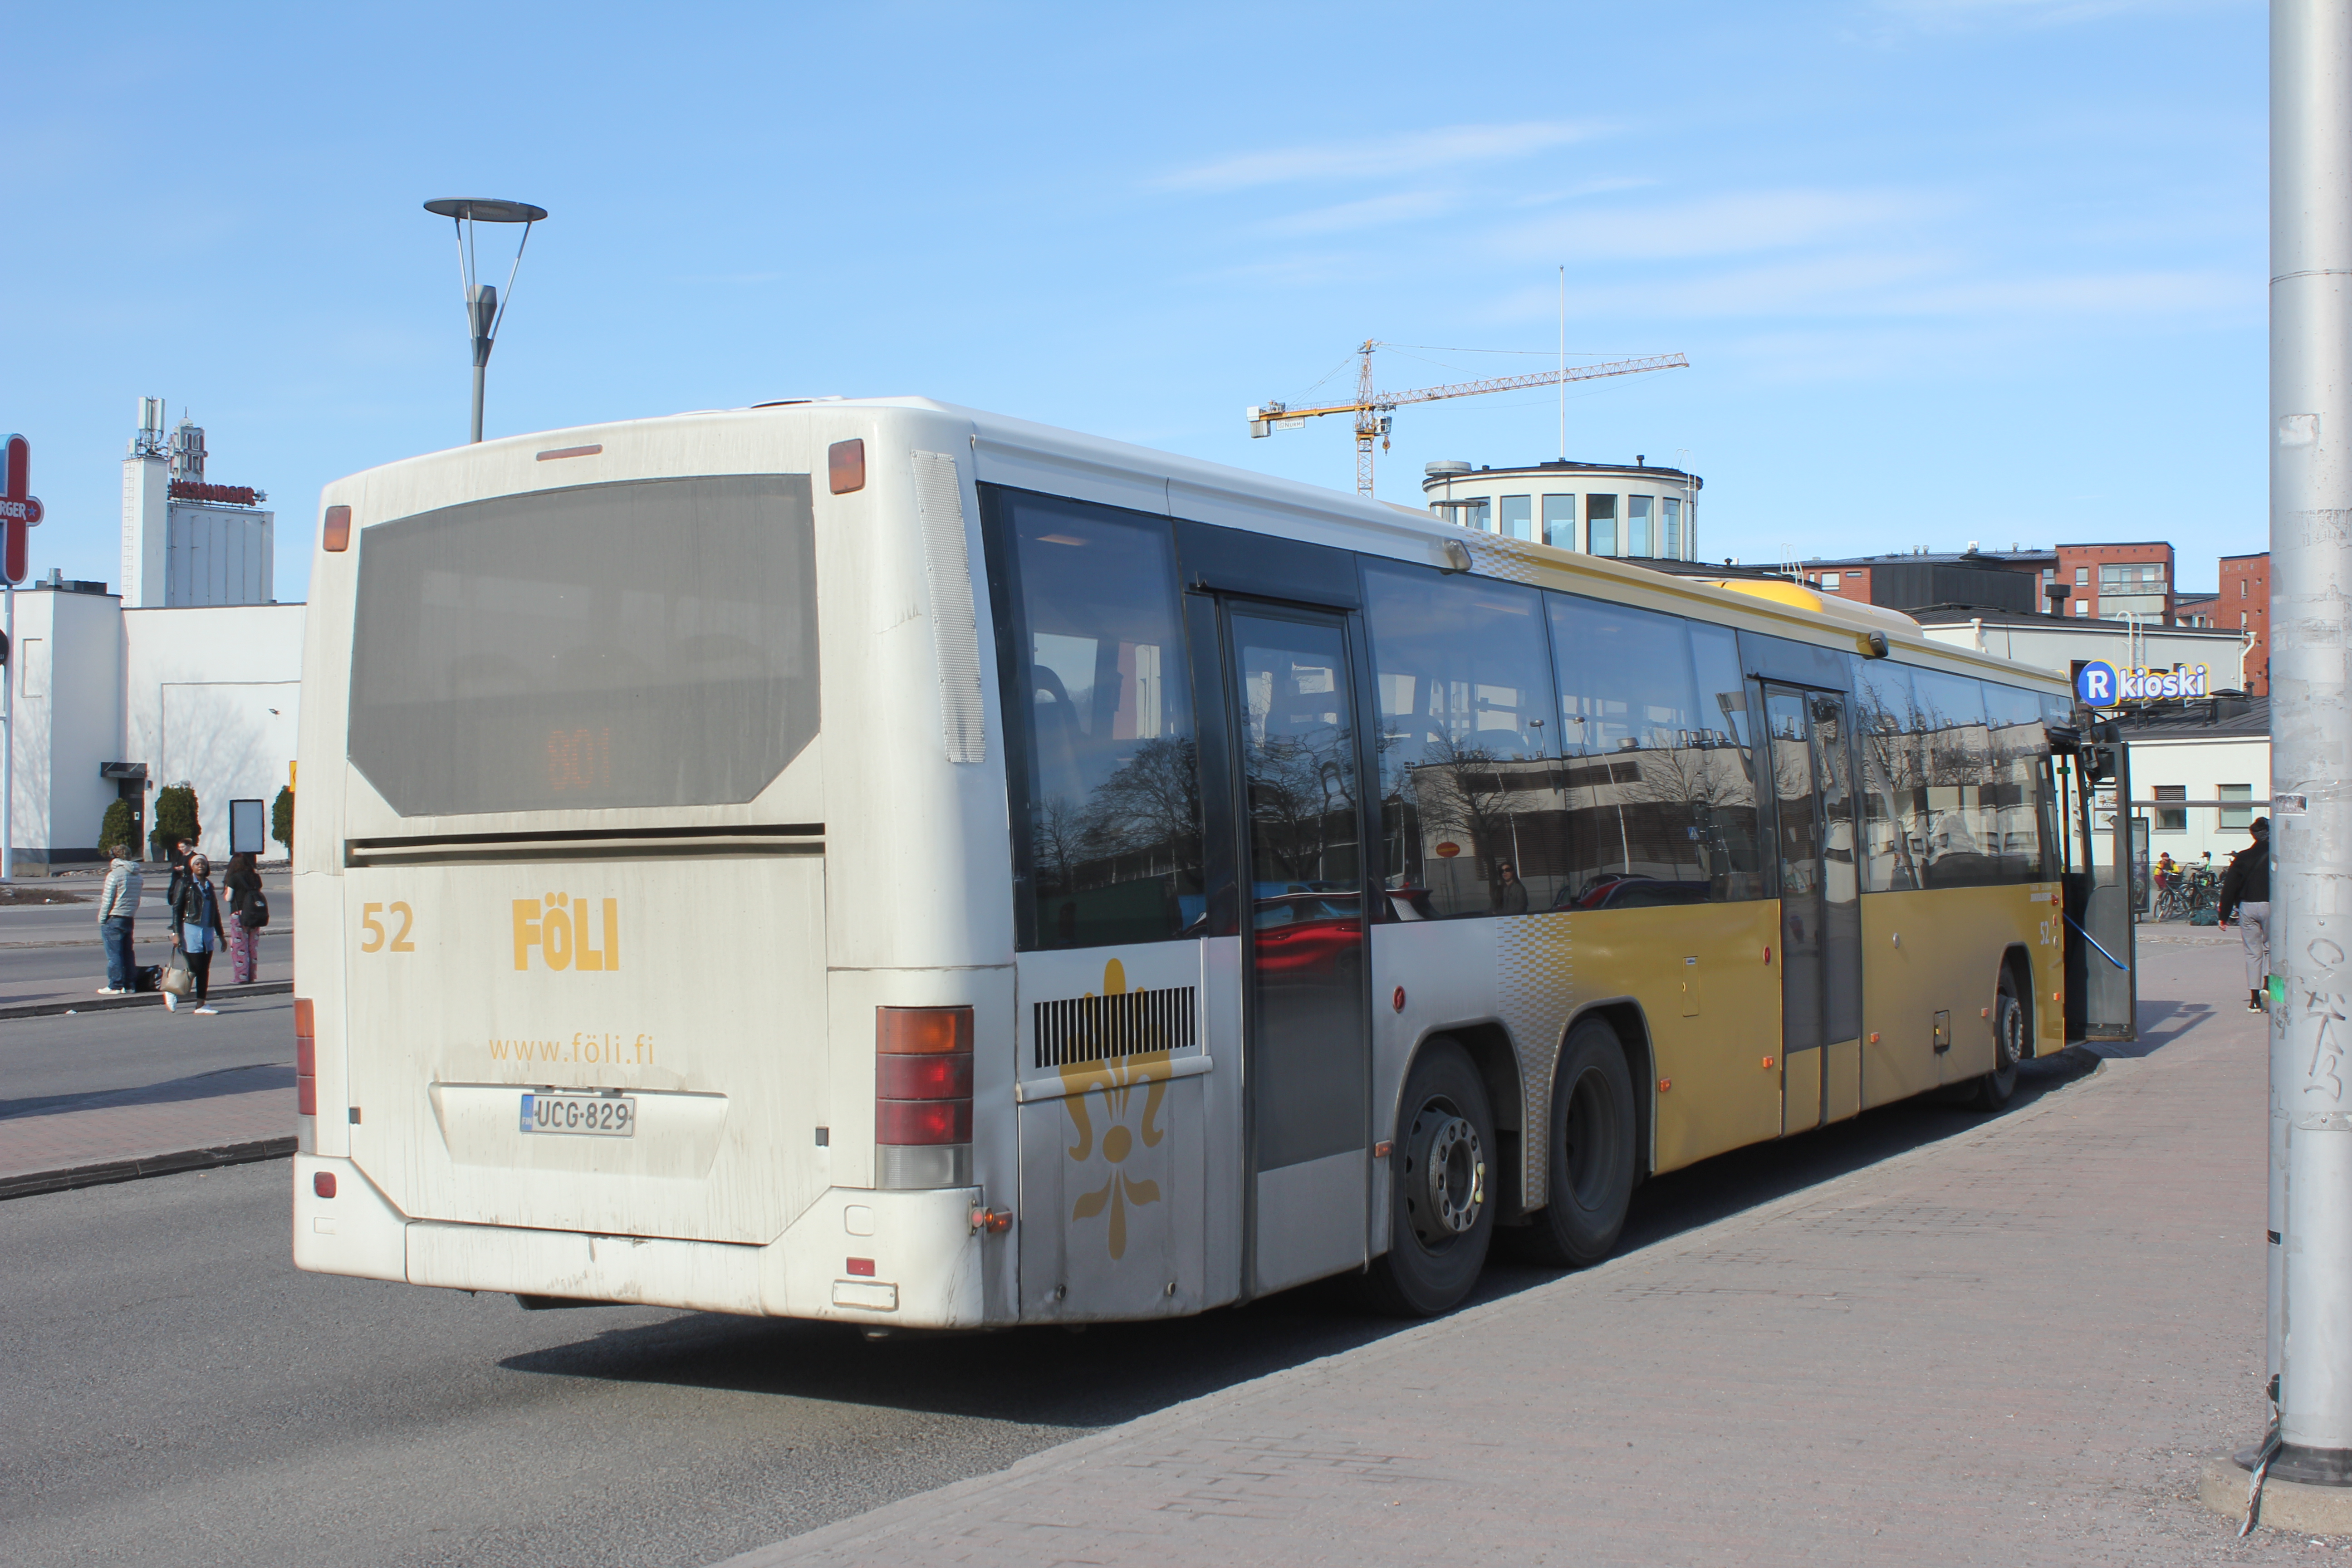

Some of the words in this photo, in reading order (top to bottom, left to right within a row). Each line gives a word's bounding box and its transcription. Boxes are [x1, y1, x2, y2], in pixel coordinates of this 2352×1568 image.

[169, 478, 256, 506] HESBURGER
[2087, 670, 2109, 699] R
[2119, 664, 2206, 699] kioski
[361, 901, 415, 953] 52
[512, 892, 619, 971] FÖLI
[489, 1032, 654, 1065] www.föli.fi
[522, 1117, 533, 1126] FIN
[538, 1100, 629, 1130] UCG-829
